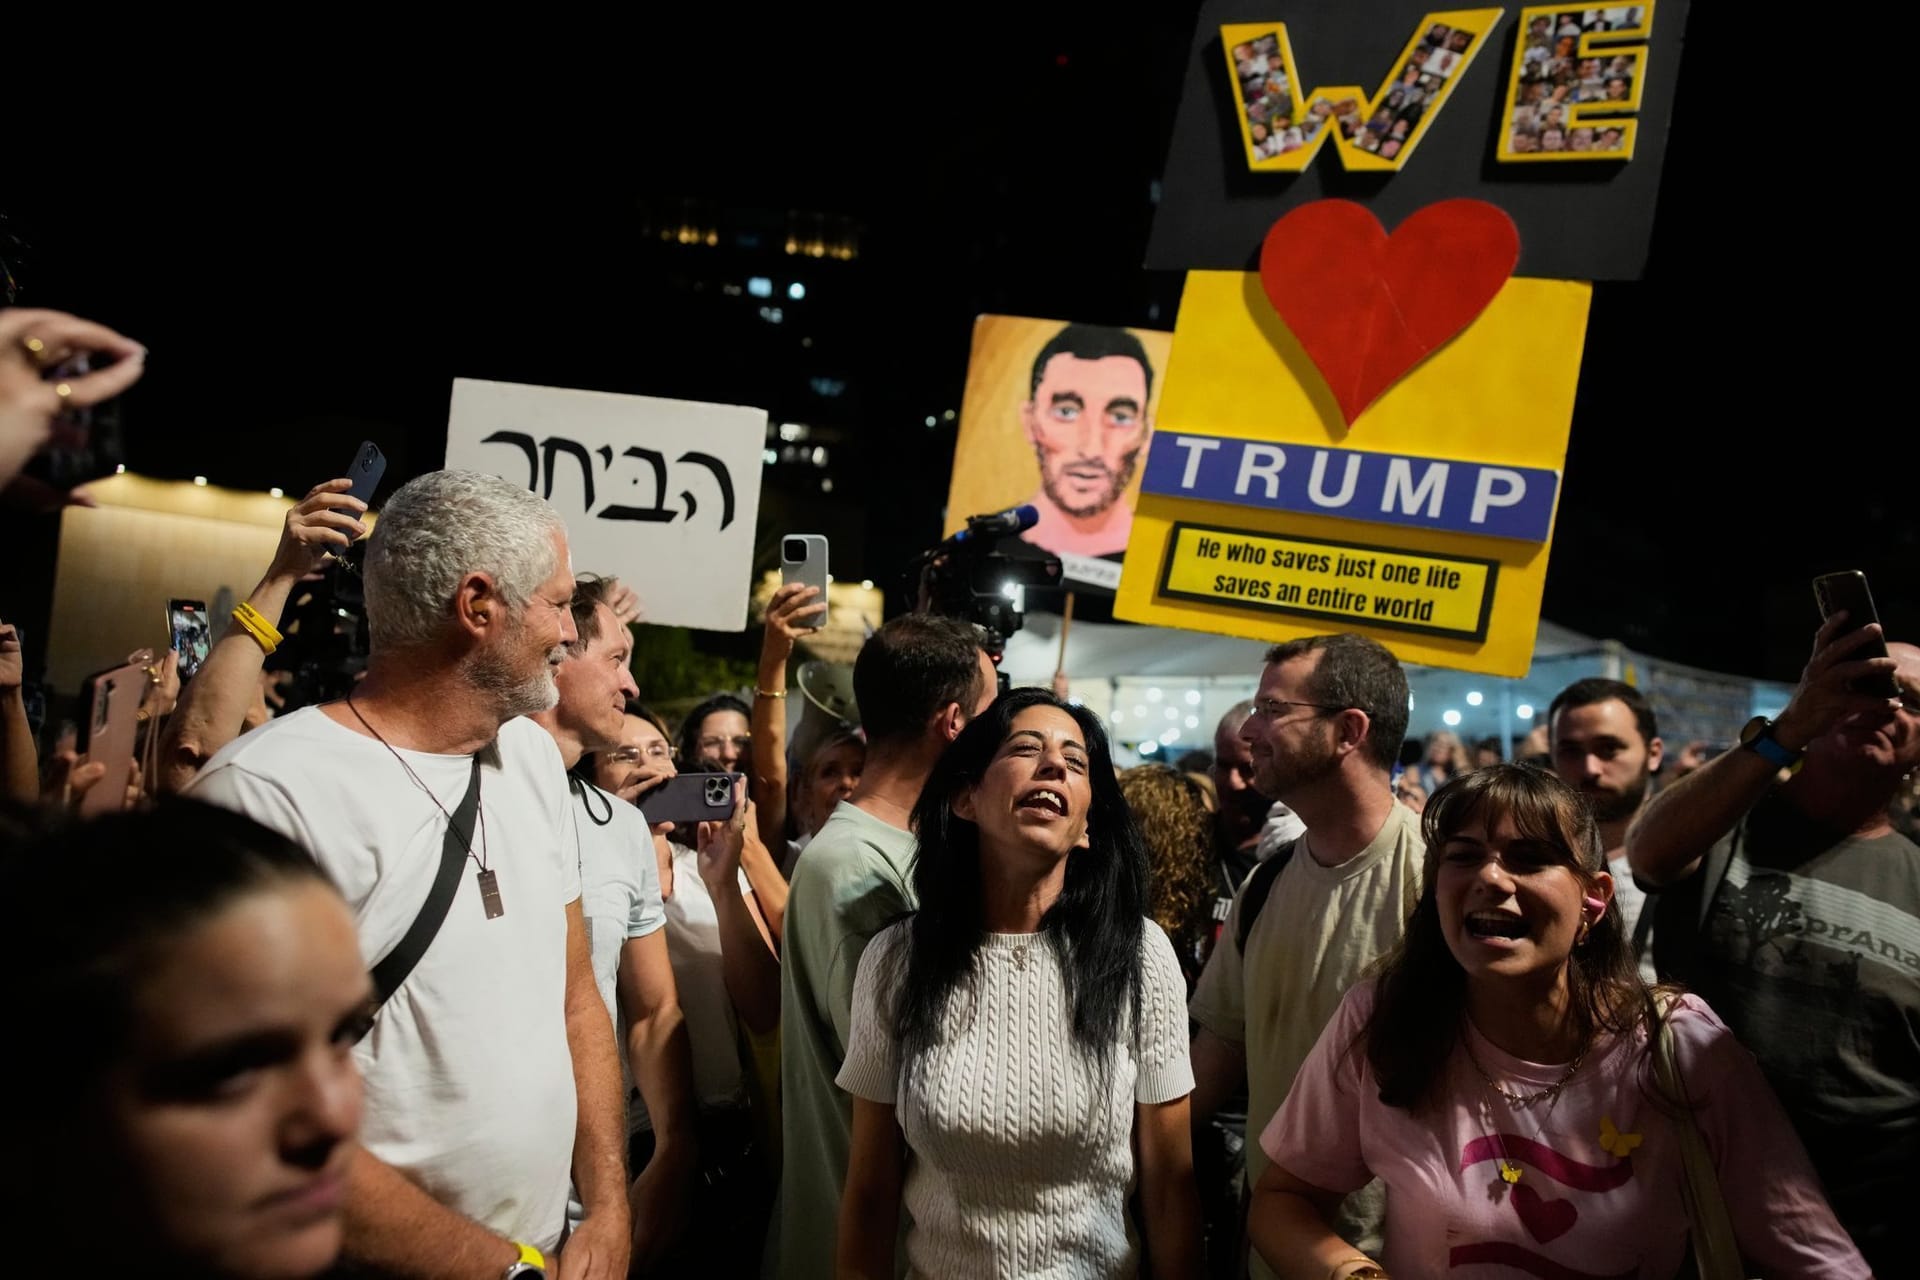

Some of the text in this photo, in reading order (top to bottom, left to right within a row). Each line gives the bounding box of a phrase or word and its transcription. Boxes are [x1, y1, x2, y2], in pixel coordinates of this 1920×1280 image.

[1220, 1, 1656, 172] WE
[1175, 436, 1527, 524] TRUMP
[1197, 537, 1461, 590] He who saves just one life
[1213, 574, 1434, 622] saves an entire world
[1804, 915, 1920, 968] prAna
